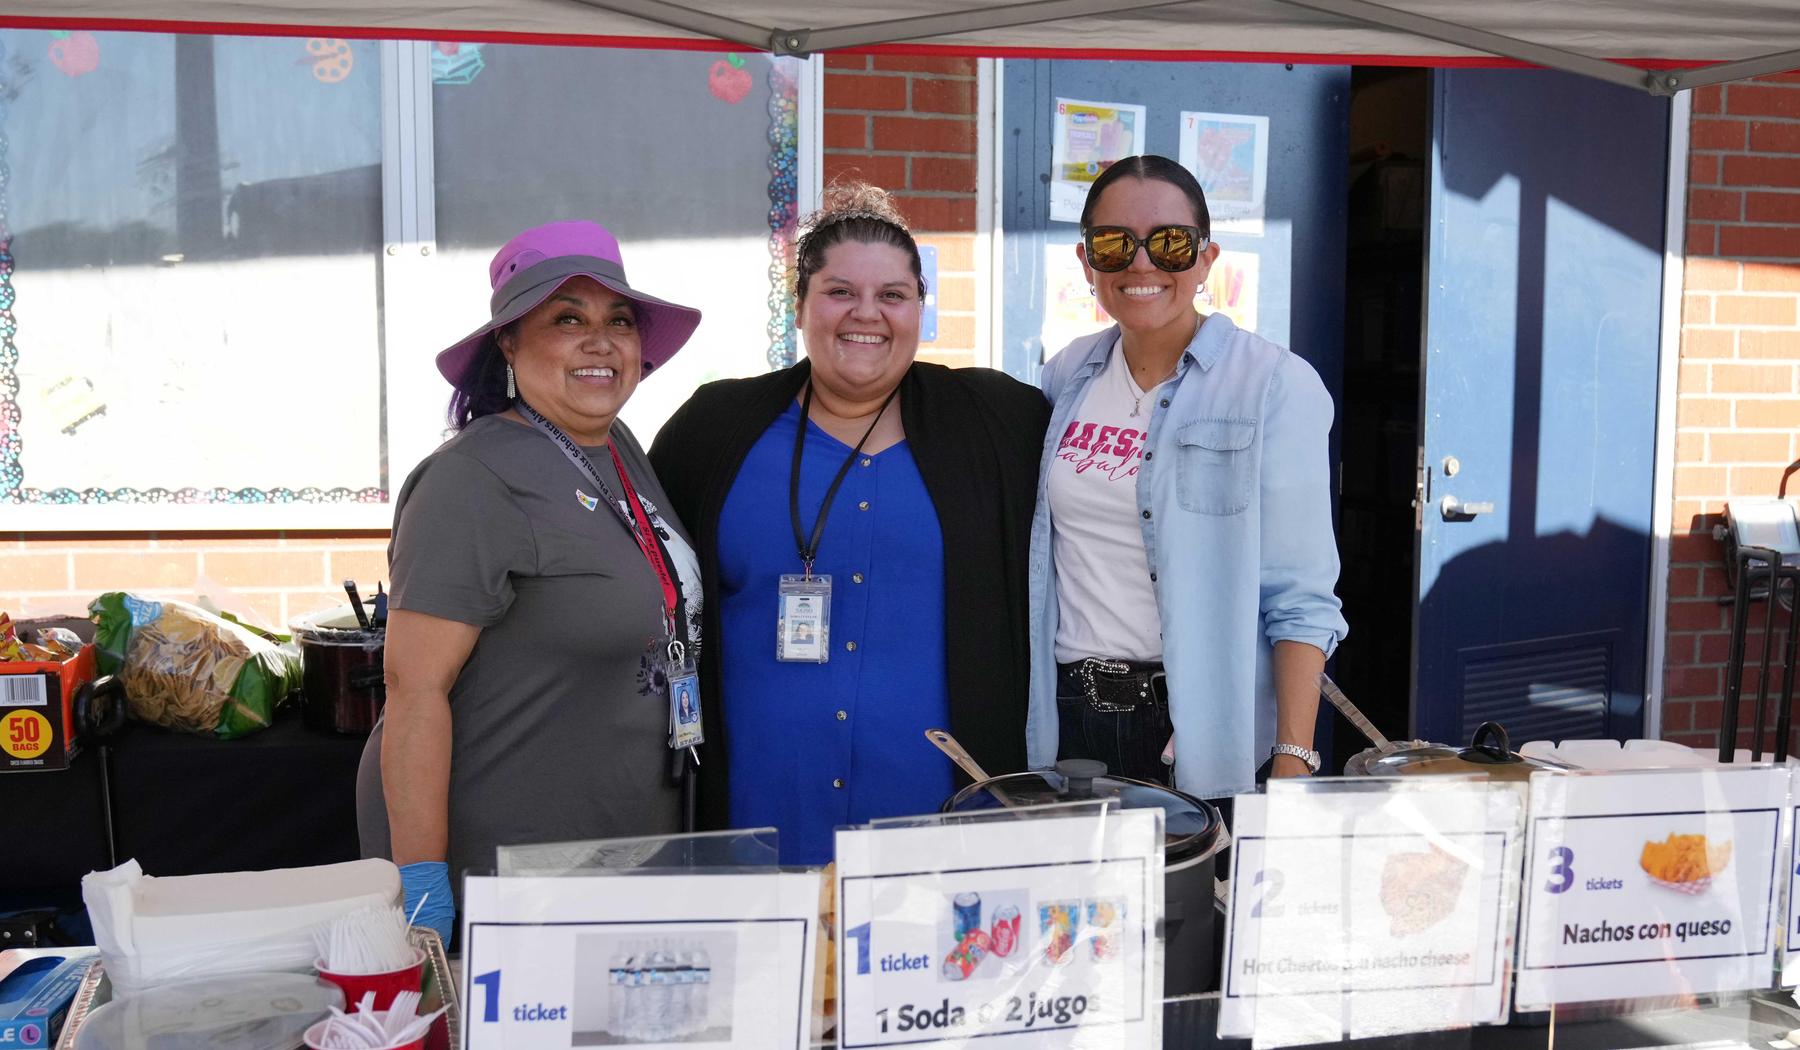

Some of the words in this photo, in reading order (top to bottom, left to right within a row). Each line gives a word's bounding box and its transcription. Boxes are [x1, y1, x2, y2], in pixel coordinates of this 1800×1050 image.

[1058, 103, 1066, 115] 6
[1186, 117, 1194, 129] 7
[544, 422, 580, 459] Scholars
[1058, 421, 1147, 458] AES
[580, 457, 610, 496] Phoenix
[9, 716, 40, 742] 50
[12, 743, 39, 751] BAGS
[1544, 846, 1575, 894] 3
[1586, 878, 1624, 891] tickets
[1251, 868, 1285, 918] 2
[846, 921, 871, 975] 1
[880, 952, 929, 972] ticket
[1563, 920, 1635, 945] Nachos
[1638, 922, 1671, 940] con
[1675, 918, 1732, 943] queso
[1243, 957, 1272, 975] Hot
[1372, 951, 1418, 970] nacho
[1420, 948, 1473, 968] cheese
[473, 969, 501, 1023] 1
[513, 1003, 568, 1022] ticket
[876, 1008, 889, 1033] 1
[897, 998, 966, 1032] Soda
[1005, 997, 1023, 1021] 2
[1024, 991, 1101, 1028] jugos
[26, 1029, 35, 1040] L
